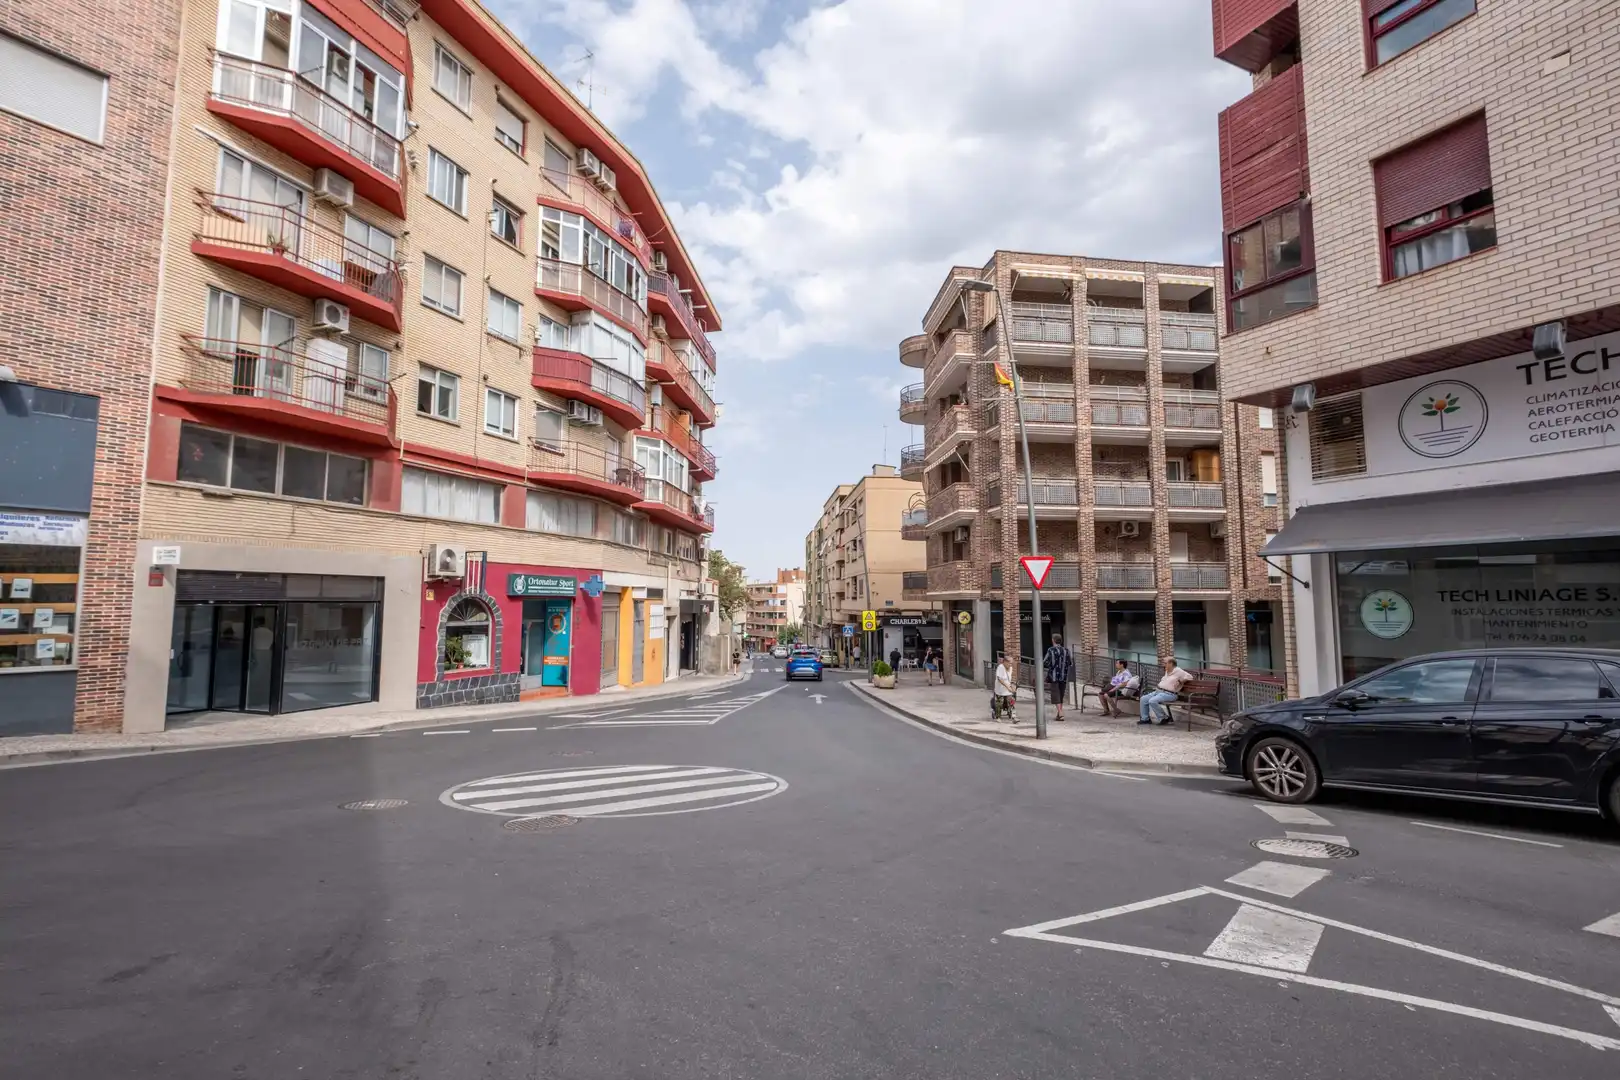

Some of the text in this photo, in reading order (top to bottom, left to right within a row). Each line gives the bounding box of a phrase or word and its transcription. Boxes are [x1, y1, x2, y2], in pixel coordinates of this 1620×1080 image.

[1516, 348, 1620, 385] TECH
[1527, 394, 1620, 417] AEROTERMIA
[1529, 423, 1616, 443] GEOTERMIA
[559, 579, 574, 589] Sport
[1437, 589, 1490, 602] TECH
[1496, 587, 1587, 602] LINIAGE
[1451, 607, 1544, 617] INSTALACIONES
[1548, 607, 1614, 618] TERMICAS
[1483, 619, 1588, 630] MANTENIMIENTO
